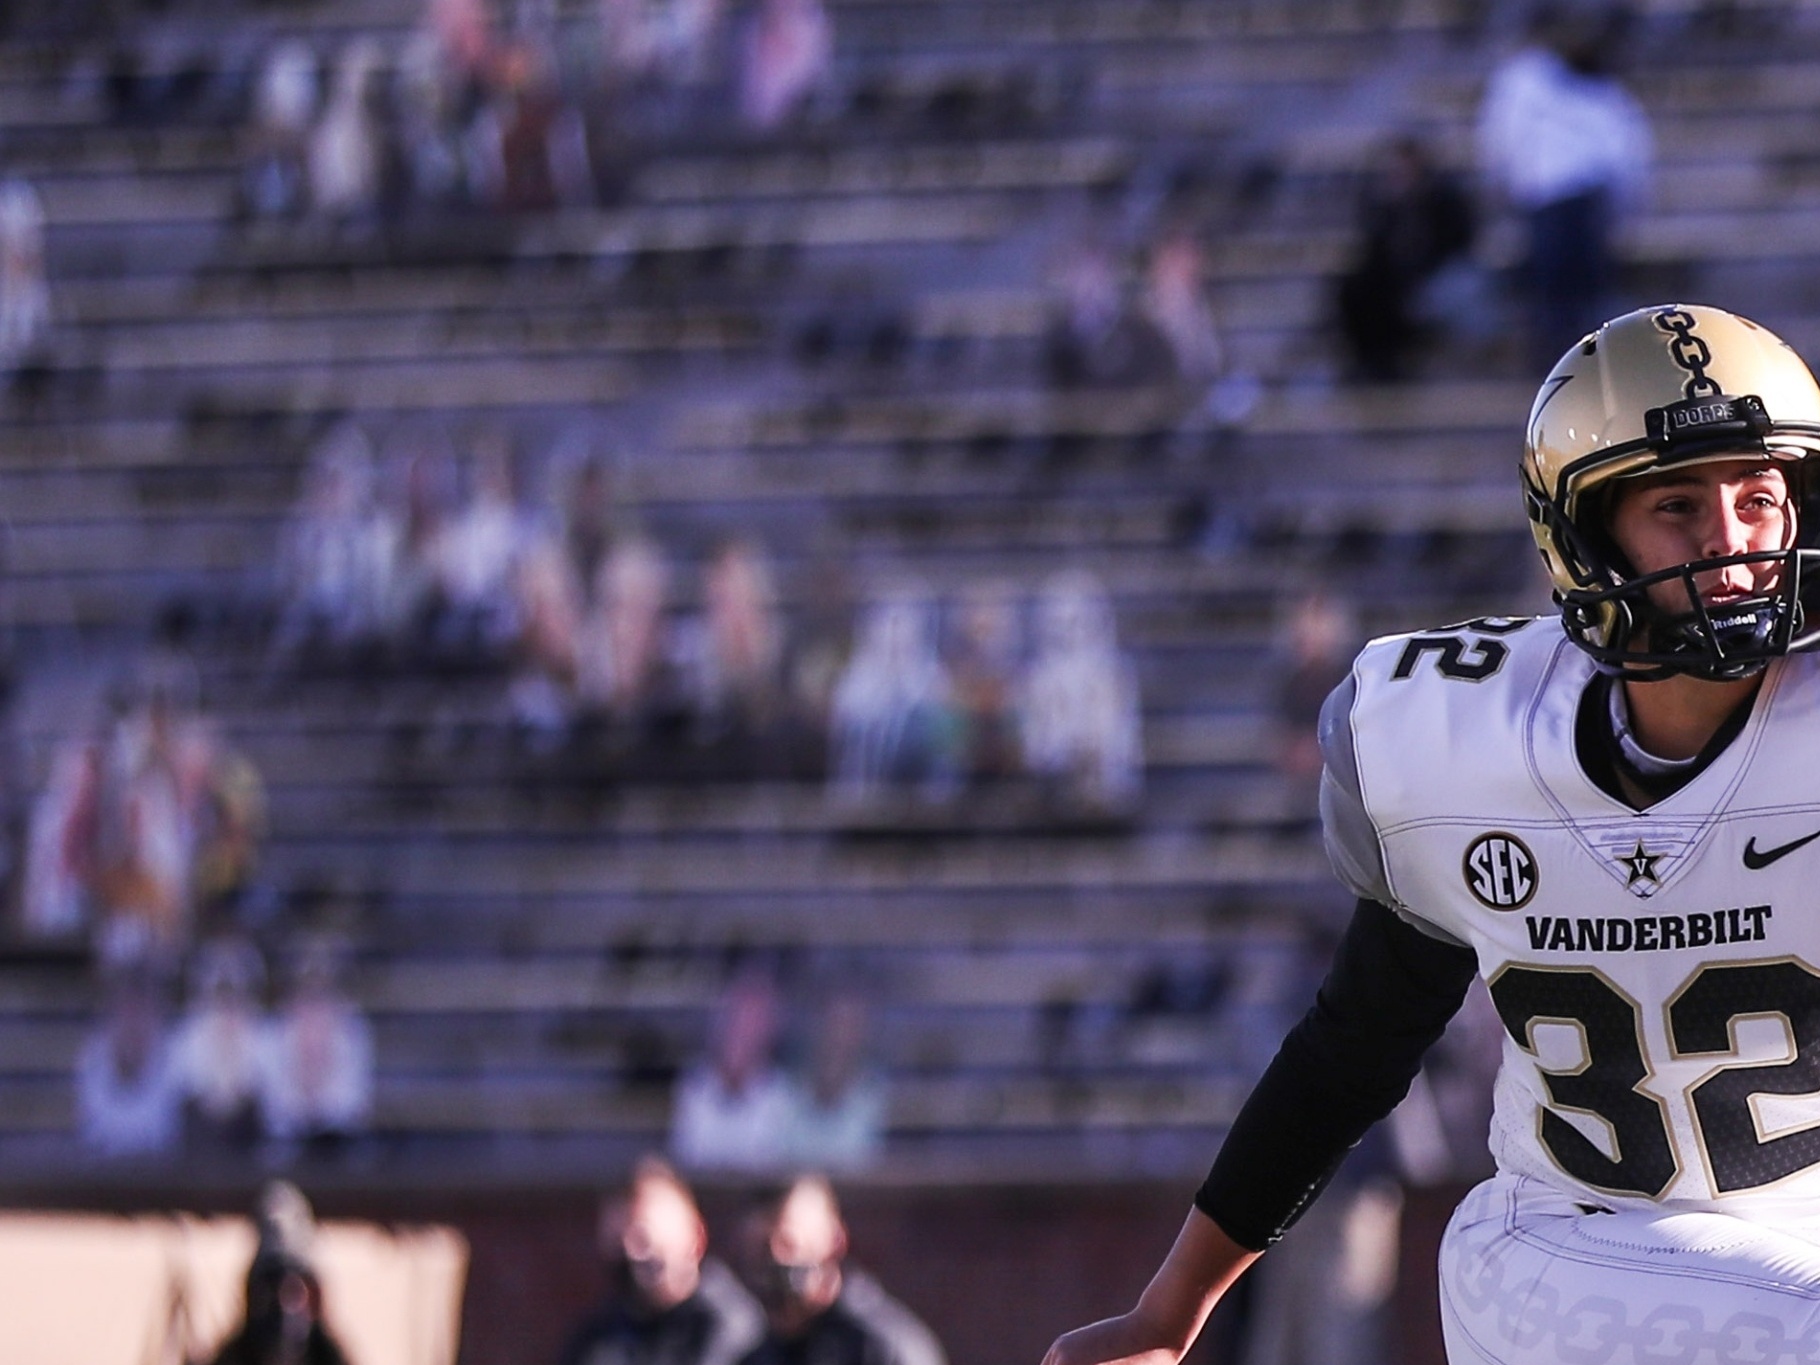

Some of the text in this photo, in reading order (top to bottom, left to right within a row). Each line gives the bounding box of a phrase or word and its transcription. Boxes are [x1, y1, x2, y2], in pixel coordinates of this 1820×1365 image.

[1711, 613, 1757, 630] Riddell
[1469, 838, 1532, 905] SEC
[1633, 858, 1648, 876] V
[1525, 904, 1773, 952] VANDERBILT
